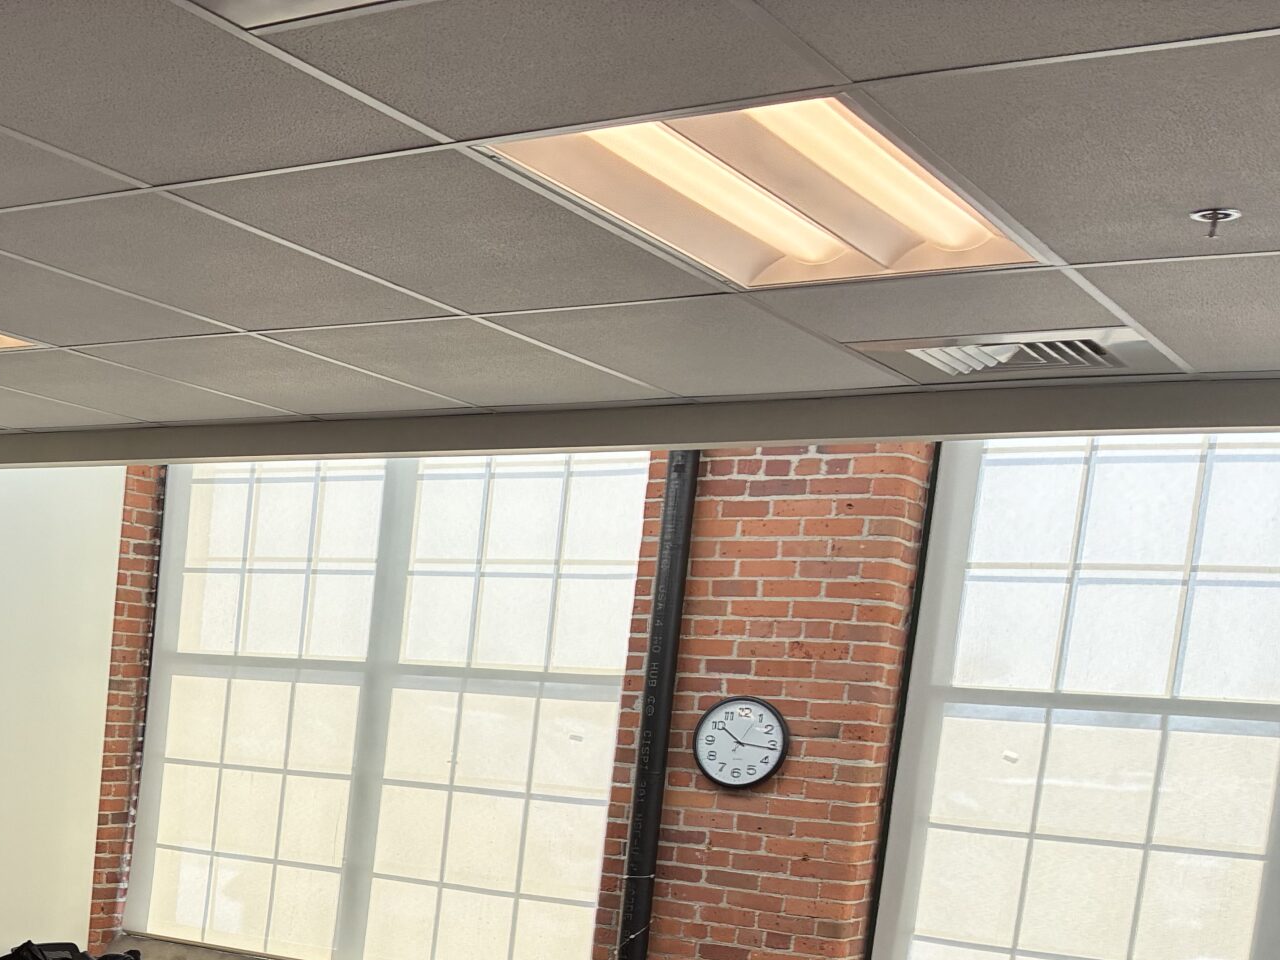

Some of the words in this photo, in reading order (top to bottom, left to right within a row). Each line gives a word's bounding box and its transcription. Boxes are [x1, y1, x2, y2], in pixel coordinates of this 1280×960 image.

[724, 711, 734, 720] 11
[739, 707, 752, 718] 12
[758, 714, 763, 723] 1
[712, 720, 726, 730] 10
[764, 724, 774, 735] 2
[705, 735, 715, 745] 9
[768, 740, 778, 750] 3
[707, 751, 717, 760] 8
[760, 755, 769, 764] 4
[719, 762, 727, 772] 7
[746, 765, 756, 775] 5
[731, 768, 741, 778] 6
